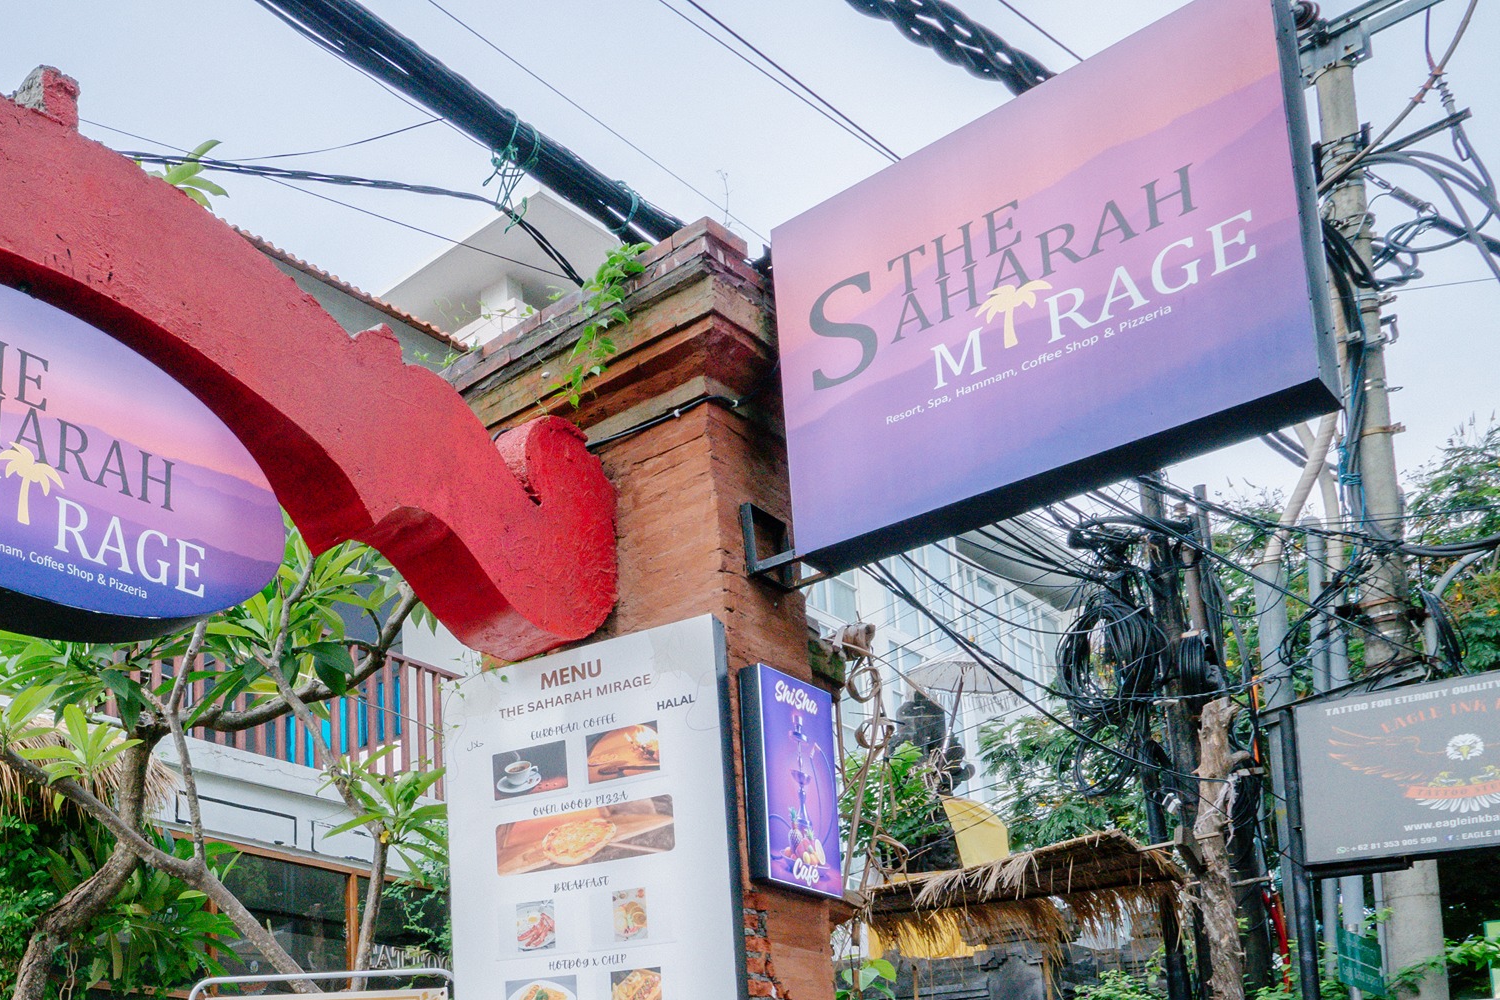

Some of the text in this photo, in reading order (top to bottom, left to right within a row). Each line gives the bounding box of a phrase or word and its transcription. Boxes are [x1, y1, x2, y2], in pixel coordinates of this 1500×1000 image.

[887, 199, 1021, 295] THE
[808, 162, 1198, 392] SAHARAH
[886, 305, 1172, 425] Resort, Spa, Hammam, Coffee Shop & Pizzeria
[30, 552, 65, 572] Coffee
[67, 564, 94, 583] Shop
[97, 574, 106, 585] &
[109, 577, 148, 599] Pizzeria
[540, 659, 602, 690] MENU
[499, 674, 651, 720] THE SAHARAH MIRAGE
[656, 694, 695, 711] HALAL
[1325, 702, 1369, 716] TATTOO
[1371, 698, 1392, 709] FOR
[1394, 688, 1448, 705] ETERNITY
[530, 713, 618, 740] EUROPEAN COFFEE
[561, 797, 592, 811] WOOD
[1383, 840, 1400, 848] 353
[1461, 830, 1492, 840] EAGLE
[553, 875, 610, 893] BREAKFAST
[792, 857, 820, 887] Café
[601, 953, 627, 966] CHIP
